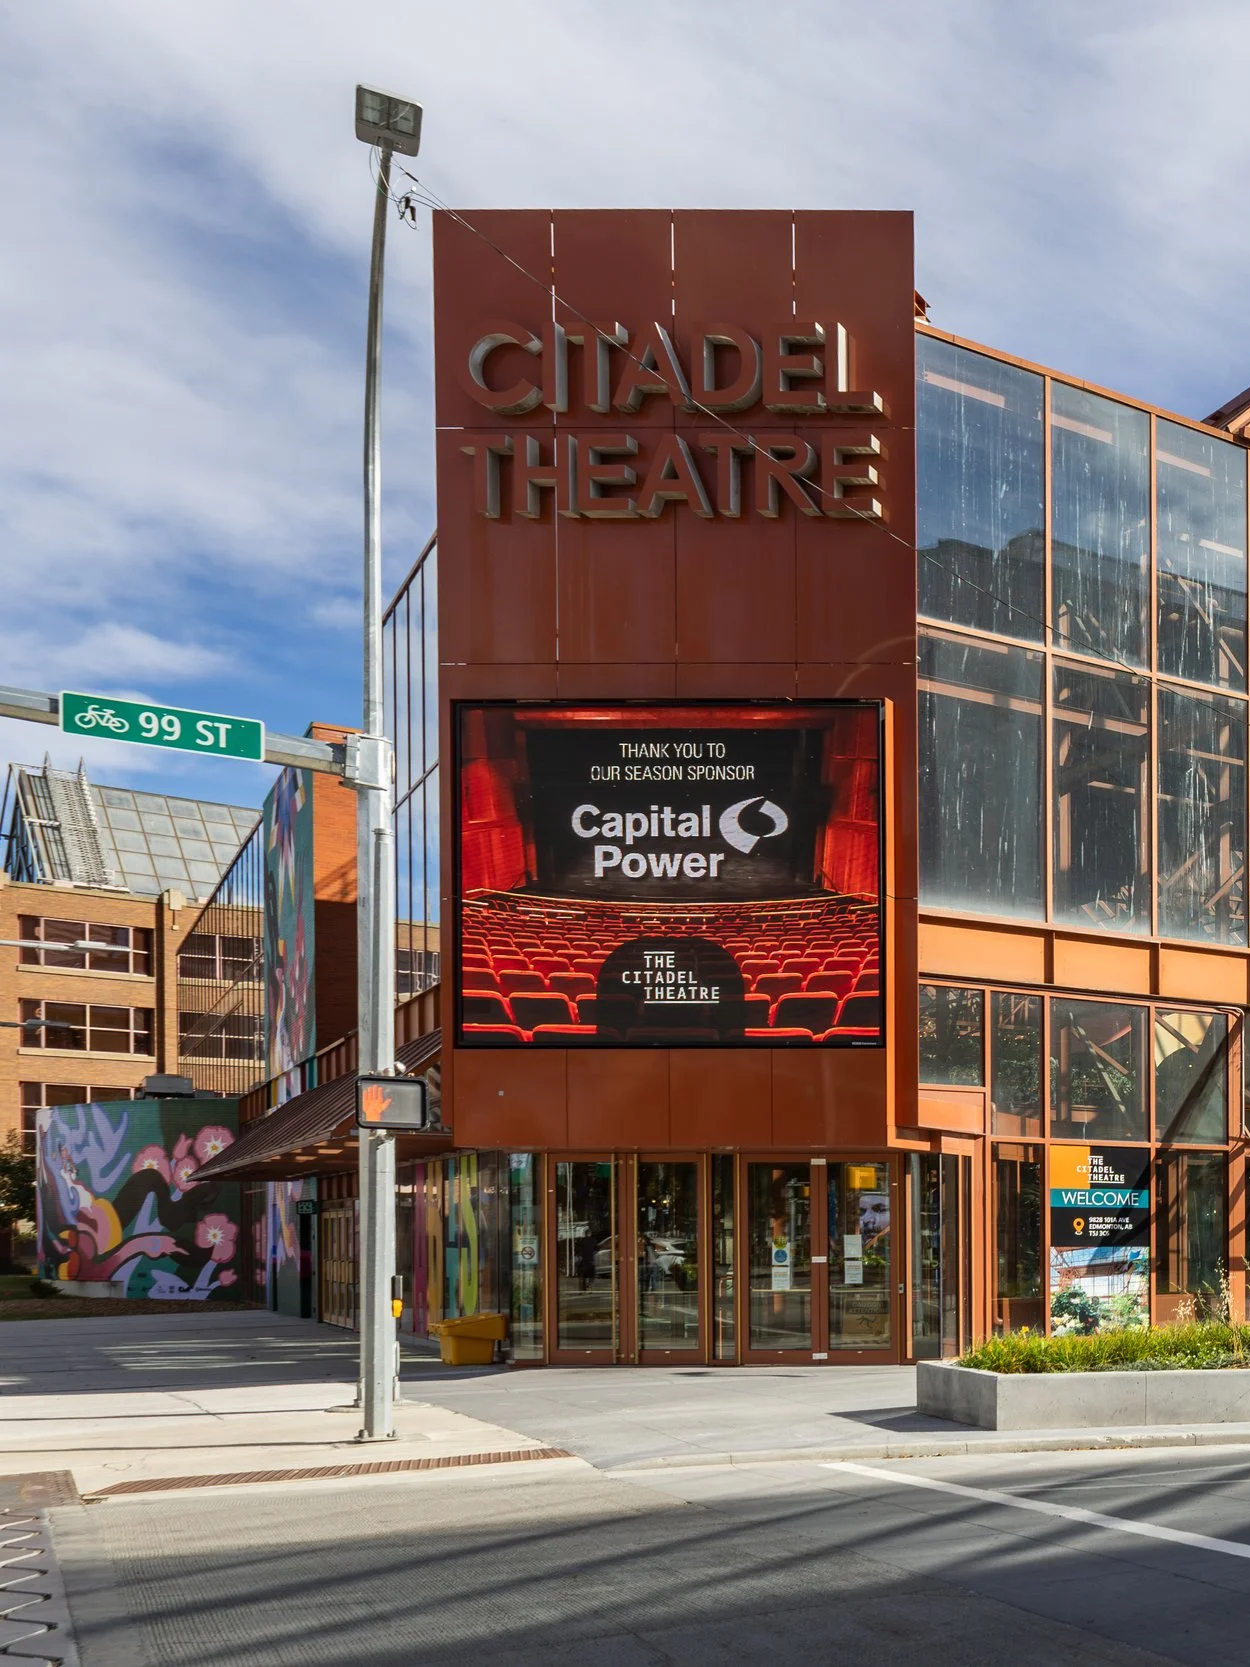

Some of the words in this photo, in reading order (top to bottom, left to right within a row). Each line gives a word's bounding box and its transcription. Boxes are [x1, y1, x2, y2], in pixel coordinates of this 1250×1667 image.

[458, 319, 883, 415] CITADEL
[458, 434, 883, 519] THEATRE
[138, 711, 182, 741] 99
[196, 720, 232, 748] ST
[619, 743, 670, 758] THANK
[673, 743, 703, 758] YOU
[706, 743, 726, 758] TO
[591, 765, 621, 781] OUR
[624, 765, 683, 781] SEASON
[687, 765, 755, 781] SPONSOR
[571, 804, 711, 845] Capital
[594, 845, 725, 878] Power
[643, 955, 675, 969] THE
[622, 971, 698, 984] CITADEL
[643, 986, 720, 1000] THEATRE
[1076, 1165, 1114, 1174] CITADEL
[1088, 1158, 1104, 1166] THE
[1088, 1173, 1125, 1182] THEATRE
[1061, 1191, 1140, 1206] WELCOME
